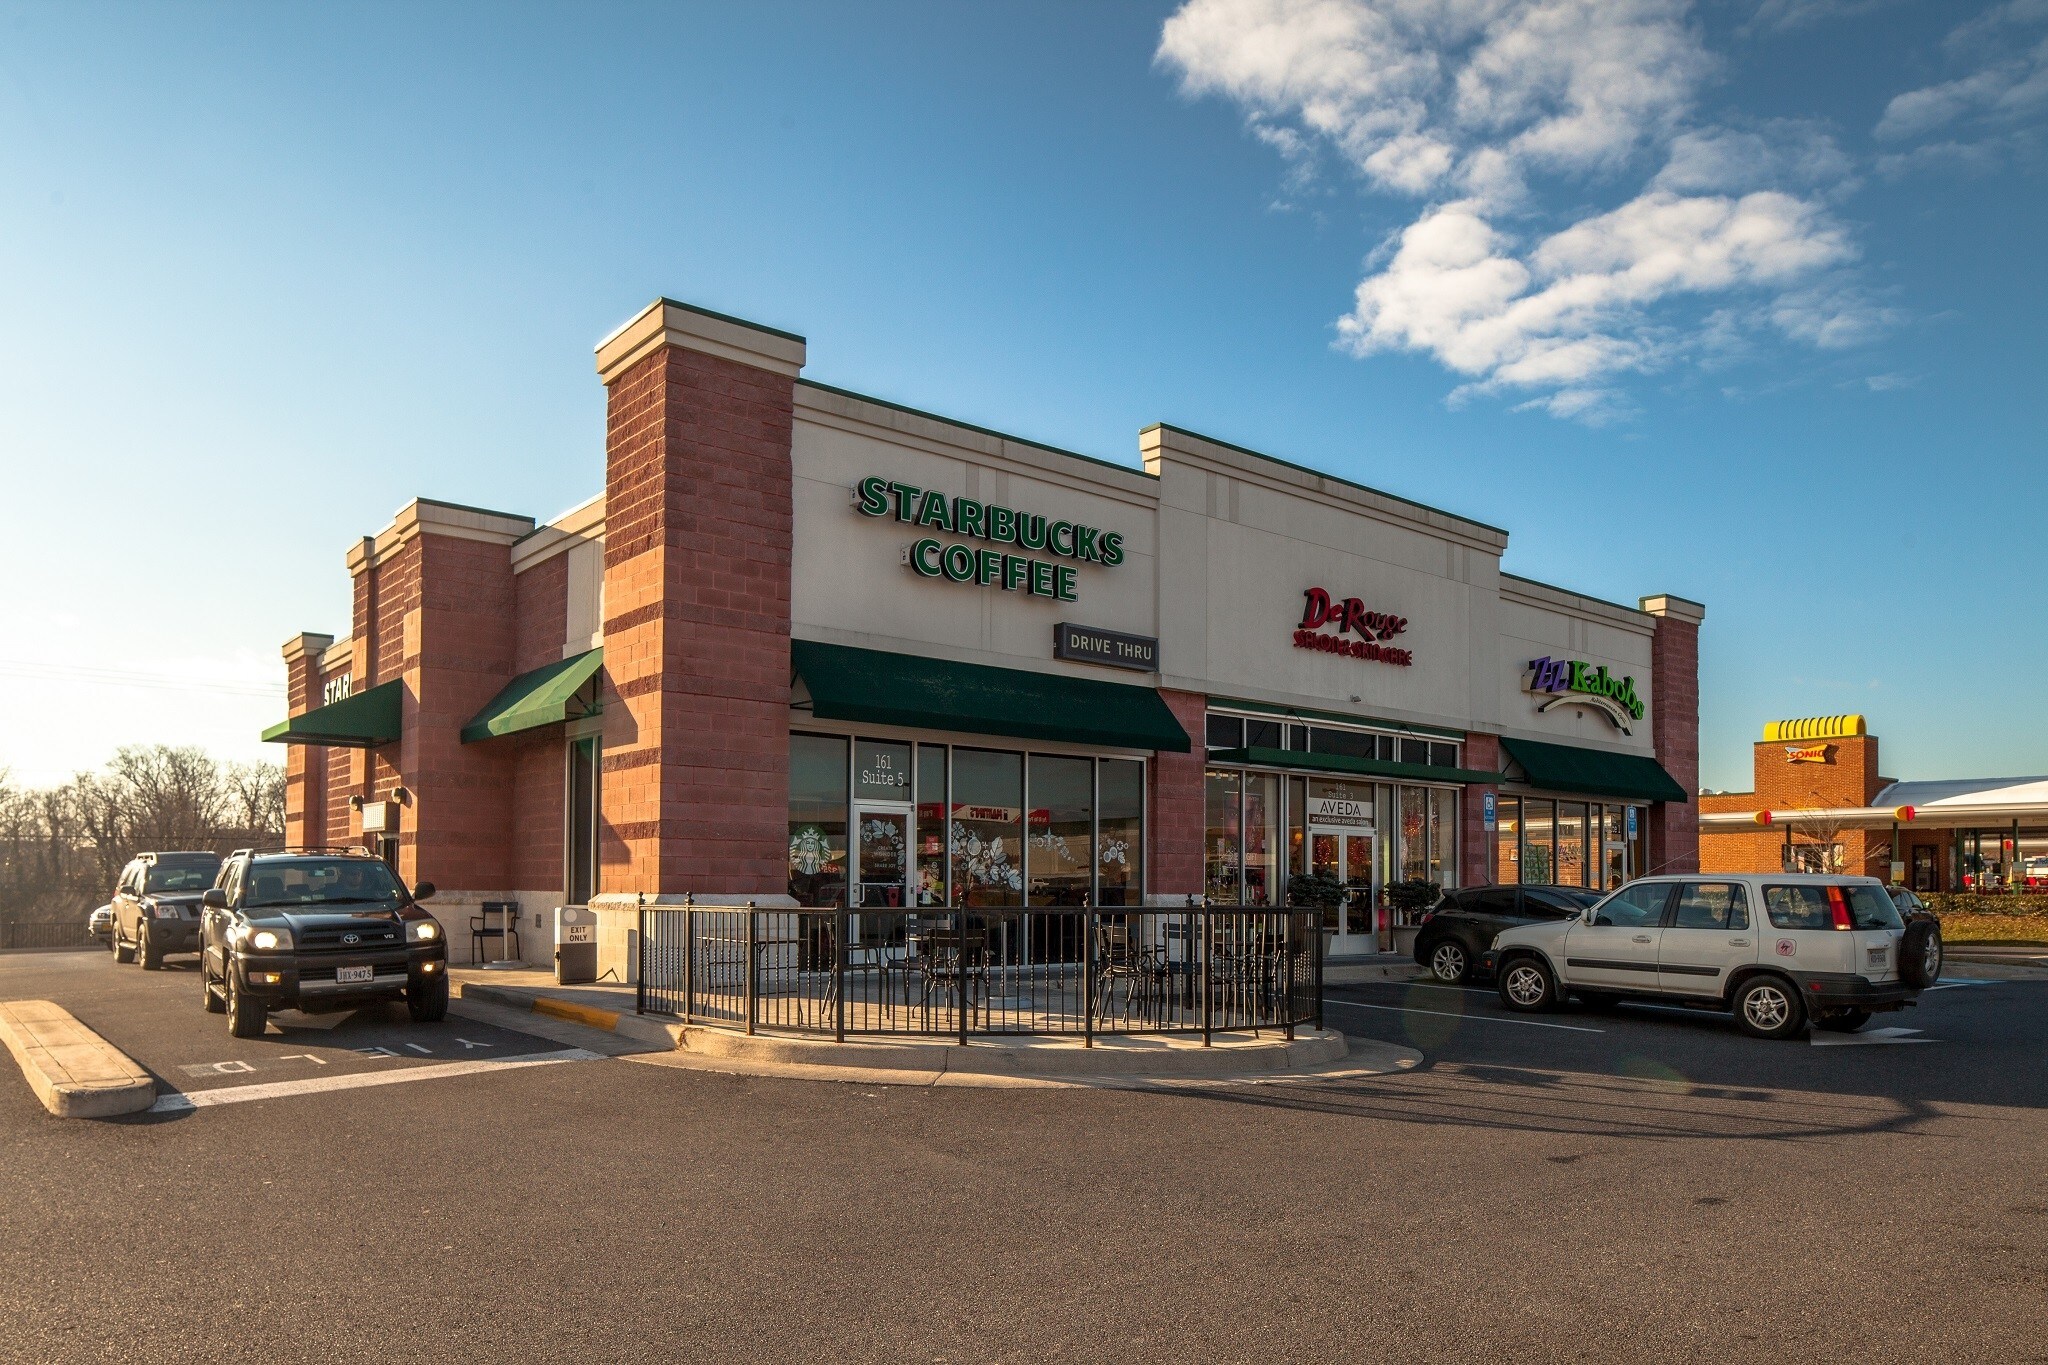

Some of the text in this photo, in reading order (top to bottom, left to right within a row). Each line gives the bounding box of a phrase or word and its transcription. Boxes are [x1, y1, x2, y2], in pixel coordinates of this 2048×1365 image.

[857, 474, 1125, 567] STARBUCKS
[909, 537, 1079, 602] COFFEE
[1071, 633, 1153, 661] DRIVE THRU
[1351, 640, 1380, 661] SKIN
[1380, 646, 1413, 667] CARE
[324, 672, 352, 707] STAR
[1567, 660, 1645, 721] Kabobs
[875, 754, 892, 770] 161
[1789, 749, 1825, 759] SONIC
[862, 770, 904, 787] Suite 5
[1328, 791, 1354, 800] Suite 3
[1320, 801, 1361, 816] AVEDA
[1320, 816, 1341, 824] exclusive
[1342, 817, 1356, 825] aveda
[1356, 819, 1369, 827] salon
[569, 934, 587, 942] ONLY
